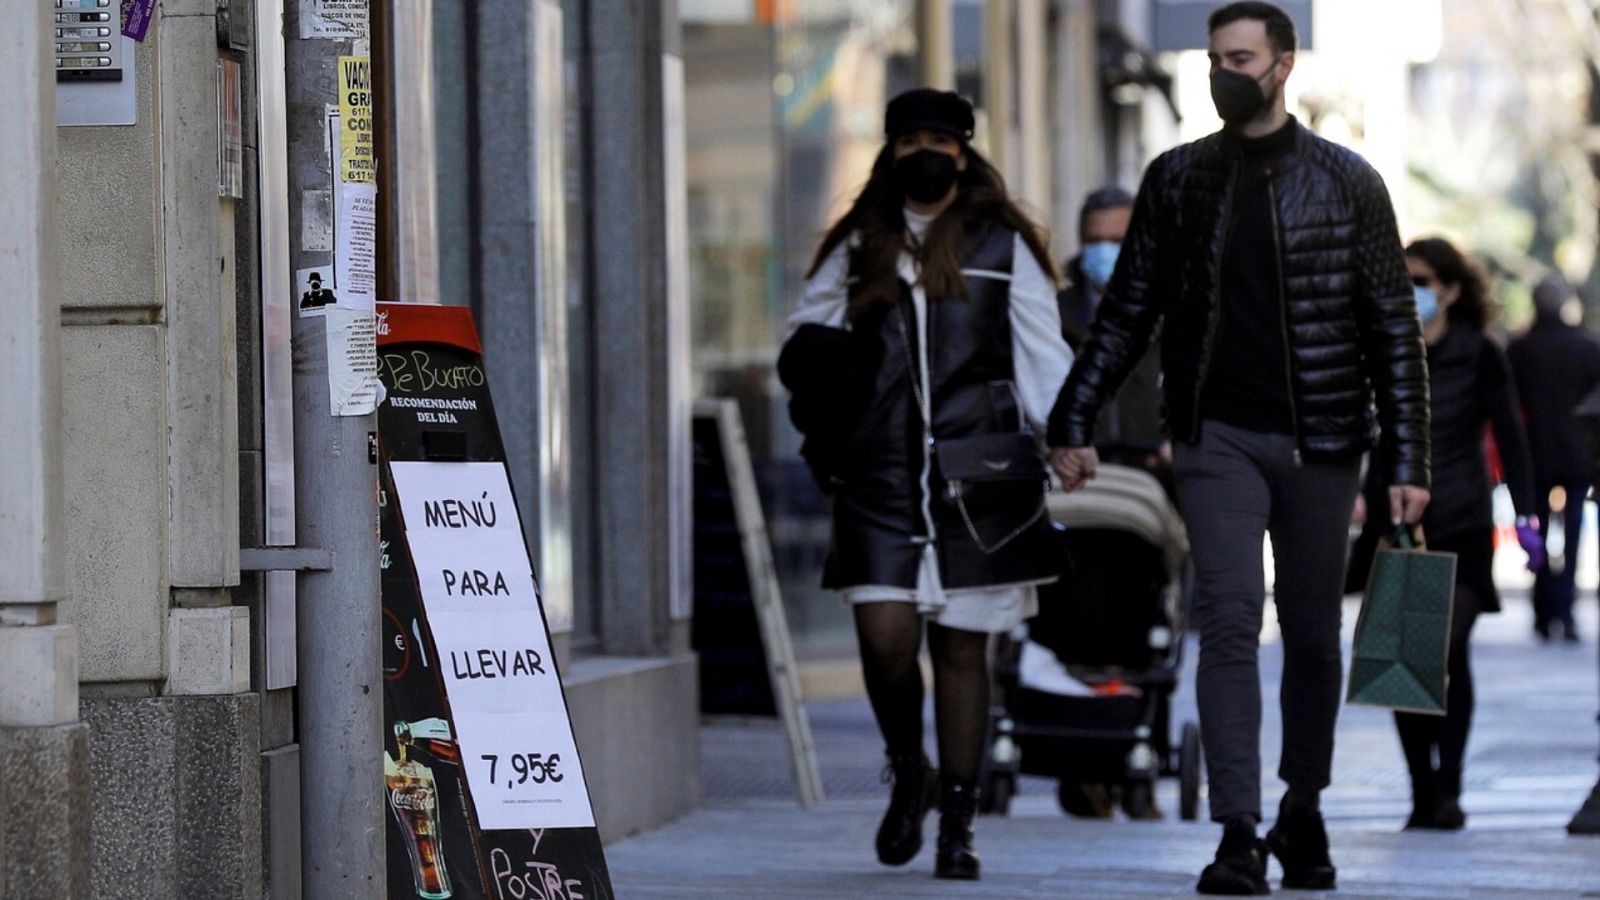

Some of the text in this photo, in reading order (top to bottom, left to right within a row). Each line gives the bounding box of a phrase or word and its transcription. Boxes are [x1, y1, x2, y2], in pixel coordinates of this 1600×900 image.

[390, 396, 477, 410] RECOMENDACIÓN
[416, 410, 458, 423] DEL DÍA
[425, 491, 496, 528] MENÚ
[442, 569, 510, 596] PARA
[451, 649, 546, 679] LLEVAR
